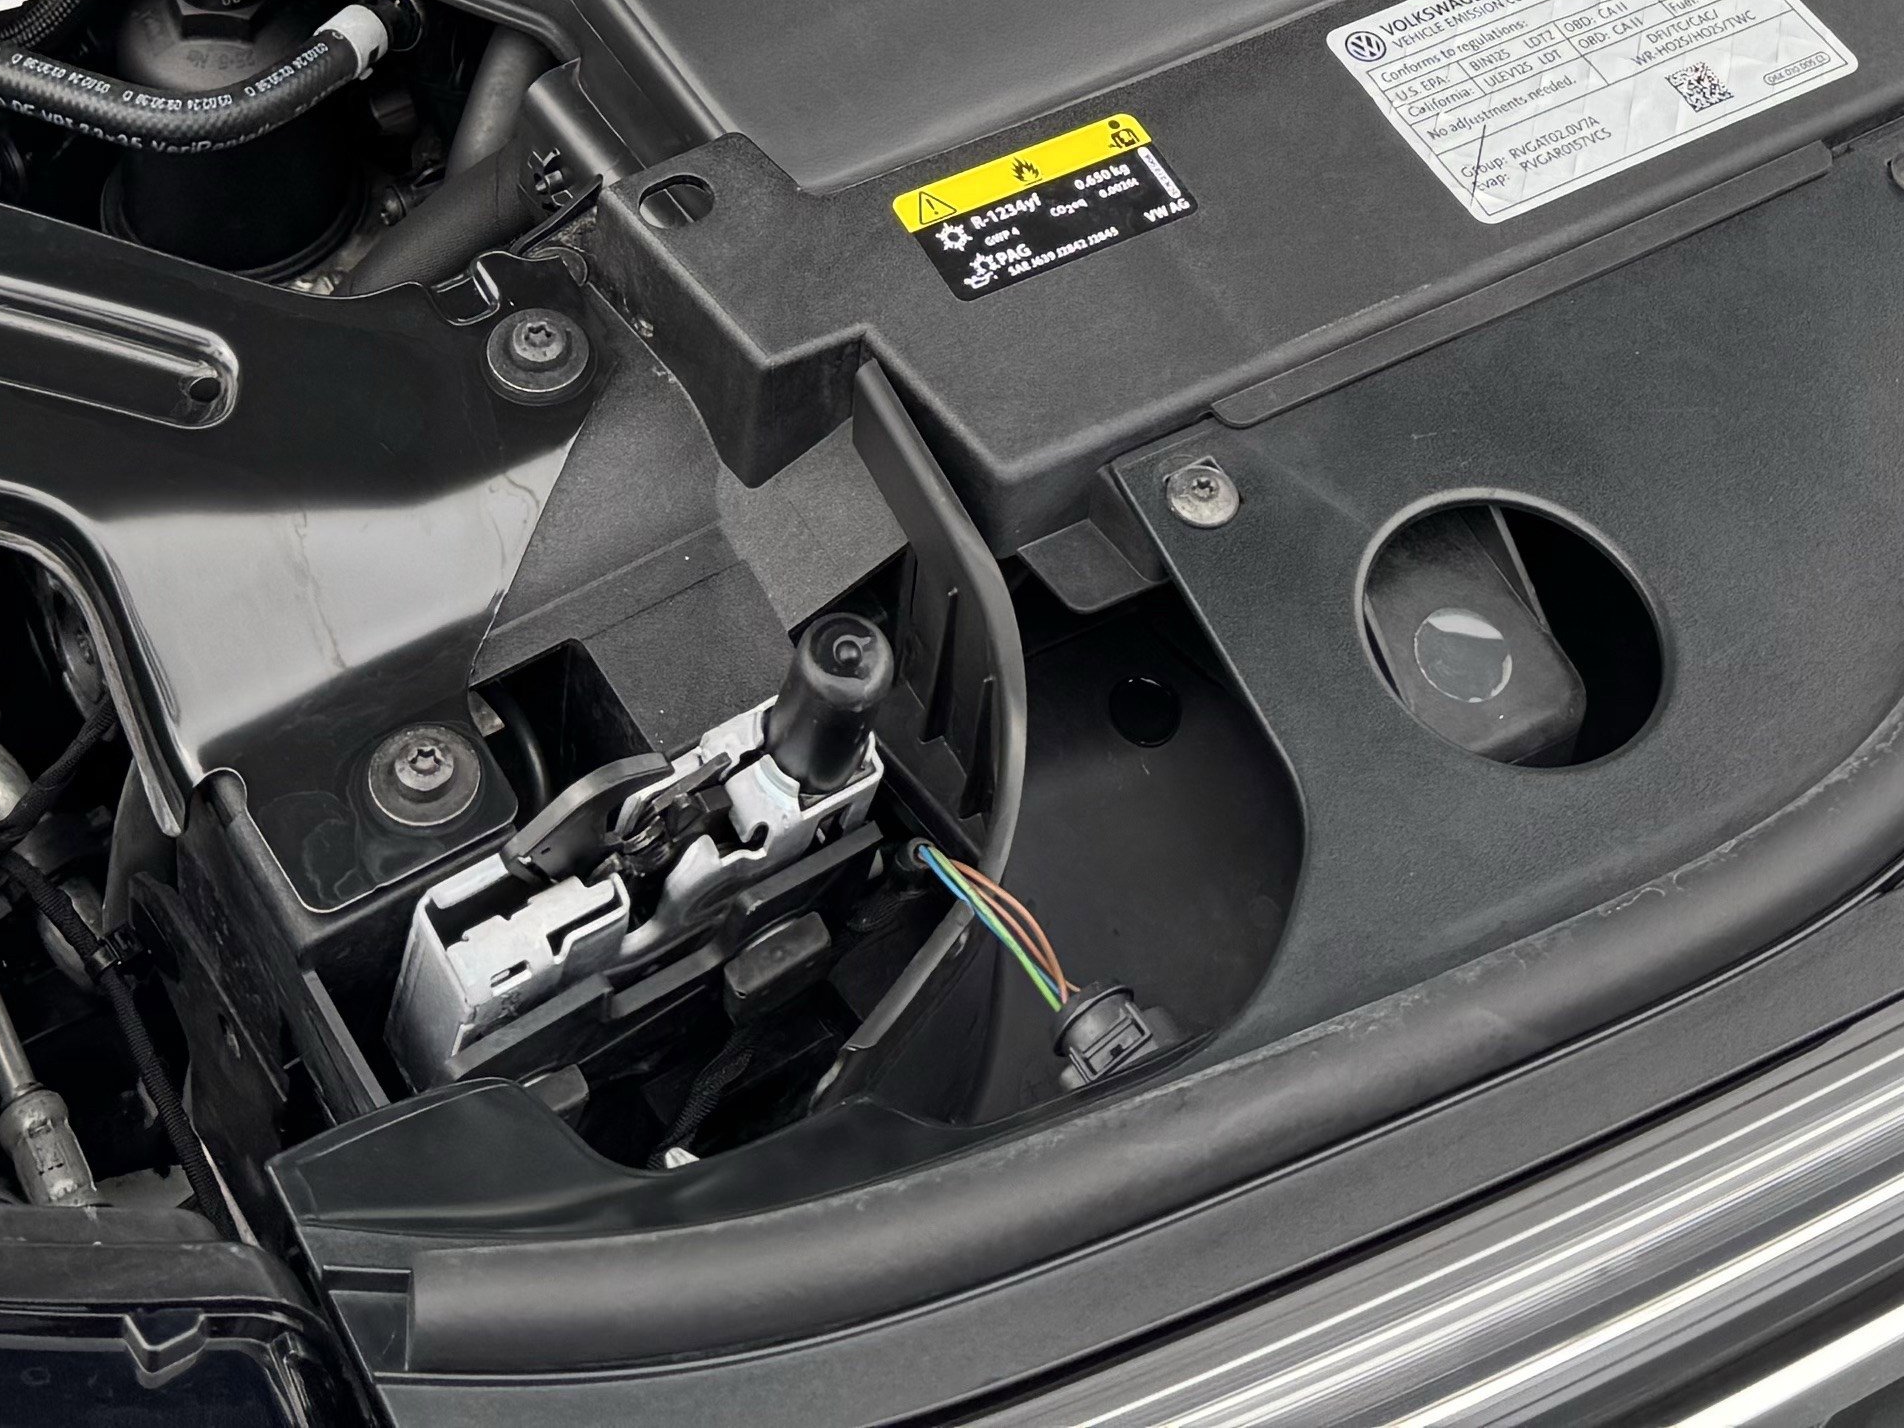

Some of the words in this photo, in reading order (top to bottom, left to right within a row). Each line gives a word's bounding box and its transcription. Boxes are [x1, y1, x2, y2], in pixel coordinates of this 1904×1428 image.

[1378, 52, 1442, 83] Conforms
[1439, 46, 1458, 59] to
[1454, 17, 1531, 55] regulations:
[1391, 21, 1445, 48] VEHICLE
[1394, 83, 1423, 101] U.S.
[1419, 72, 1451, 91] EPA:
[1467, 47, 1512, 71] BIN125
[1522, 29, 1557, 49] LDT2
[1562, 13, 1597, 33] OBD:
[1596, 5, 1618, 19] CA
[1405, 84, 1476, 119] California:
[1482, 60, 1535, 87] ULEV125
[1537, 49, 1563, 65] LDT
[1576, 30, 1612, 49] OBD:
[1611, 21, 1633, 35] CA
[1426, 125, 1450, 141] No
[1445, 93, 1530, 135] adjustments
[1524, 74, 1578, 101] needed.
[968, 192, 1045, 232] R-1234yf
[1108, 160, 1132, 178] kg
[1459, 153, 1510, 181] Group:
[1143, 205, 1170, 222] VW
[1166, 197, 1191, 213] AG
[994, 242, 1032, 265] PAG
